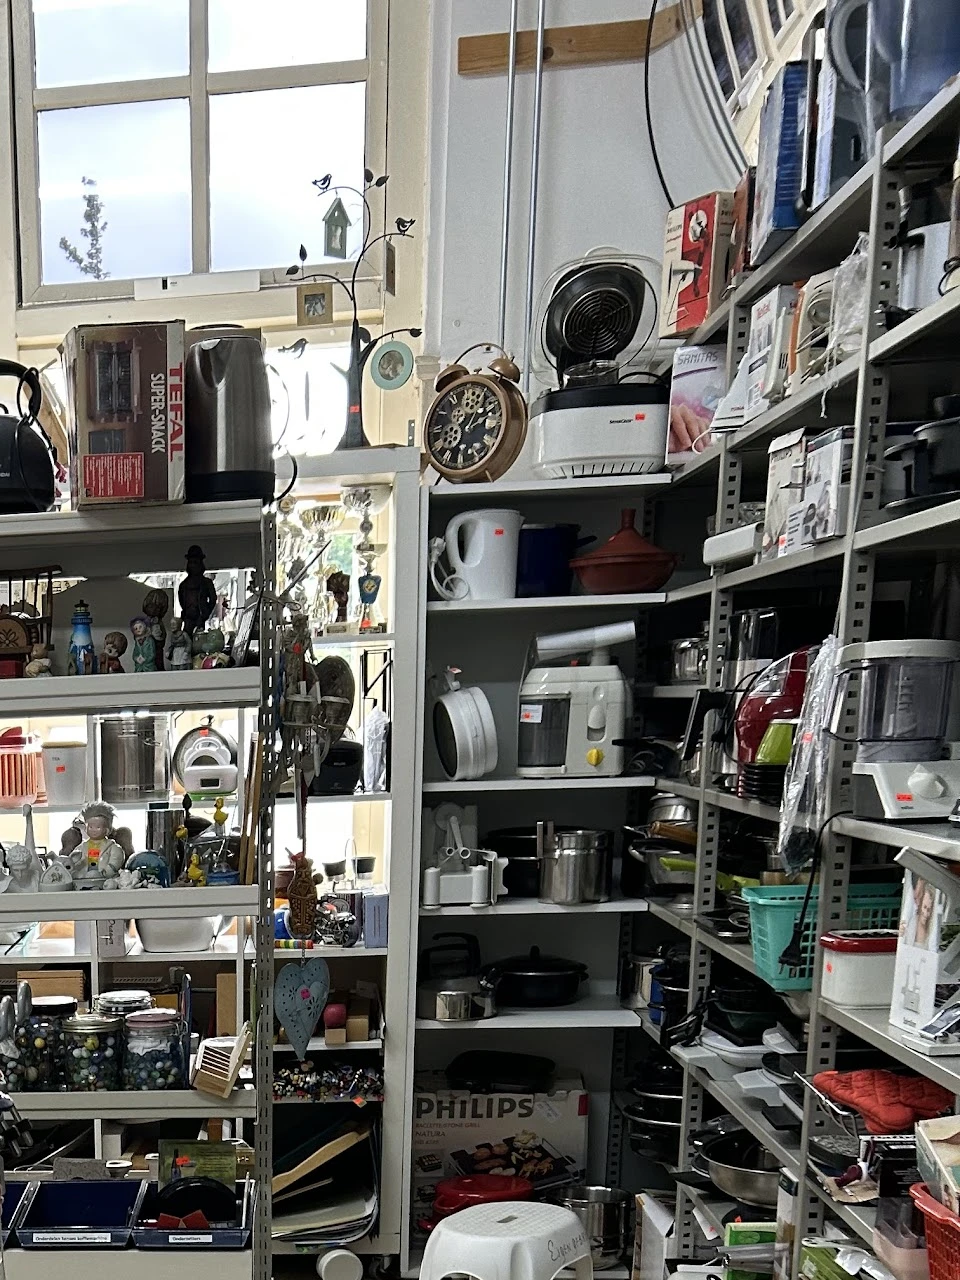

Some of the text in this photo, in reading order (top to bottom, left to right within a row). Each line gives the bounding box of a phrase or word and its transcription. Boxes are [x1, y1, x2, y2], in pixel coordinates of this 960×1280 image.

[677, 351, 718, 365] SANITAS
[150, 373, 166, 453] SUPER-SNACK
[169, 362, 185, 462] TEFAL
[416, 1097, 534, 1119] PHILIPS
[415, 1130, 446, 1138] NATURA
